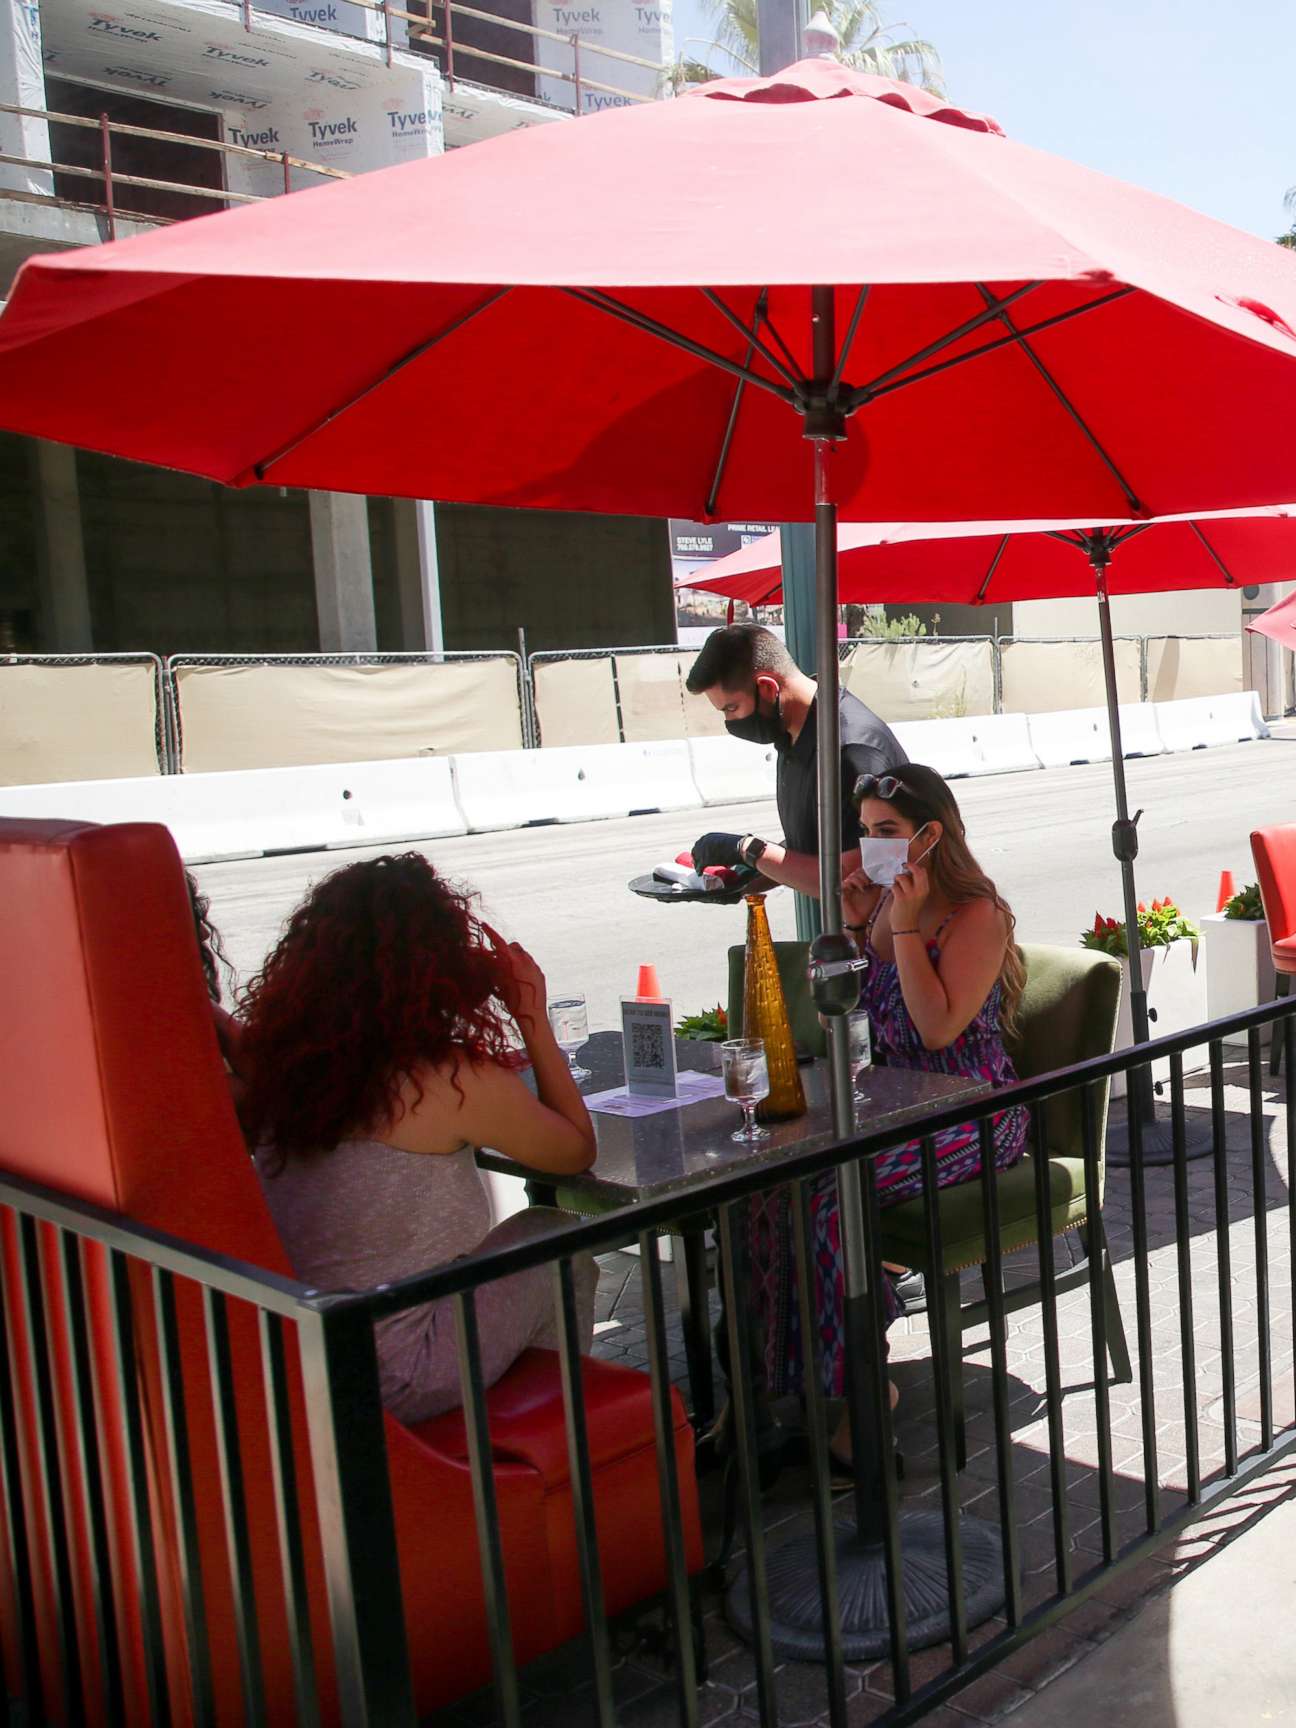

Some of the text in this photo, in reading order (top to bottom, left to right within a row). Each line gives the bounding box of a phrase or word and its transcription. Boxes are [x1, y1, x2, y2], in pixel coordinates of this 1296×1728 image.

[290, 5, 336, 22] Tyvek
[553, 7, 600, 24] Tyvek
[91, 18, 163, 41] Tyvek
[205, 46, 270, 67] Tyvek
[584, 93, 633, 111] Tyvek
[228, 127, 281, 147] Tyvek
[308, 117, 358, 141] Tyvek
[312, 138, 354, 149] HomeWrap
